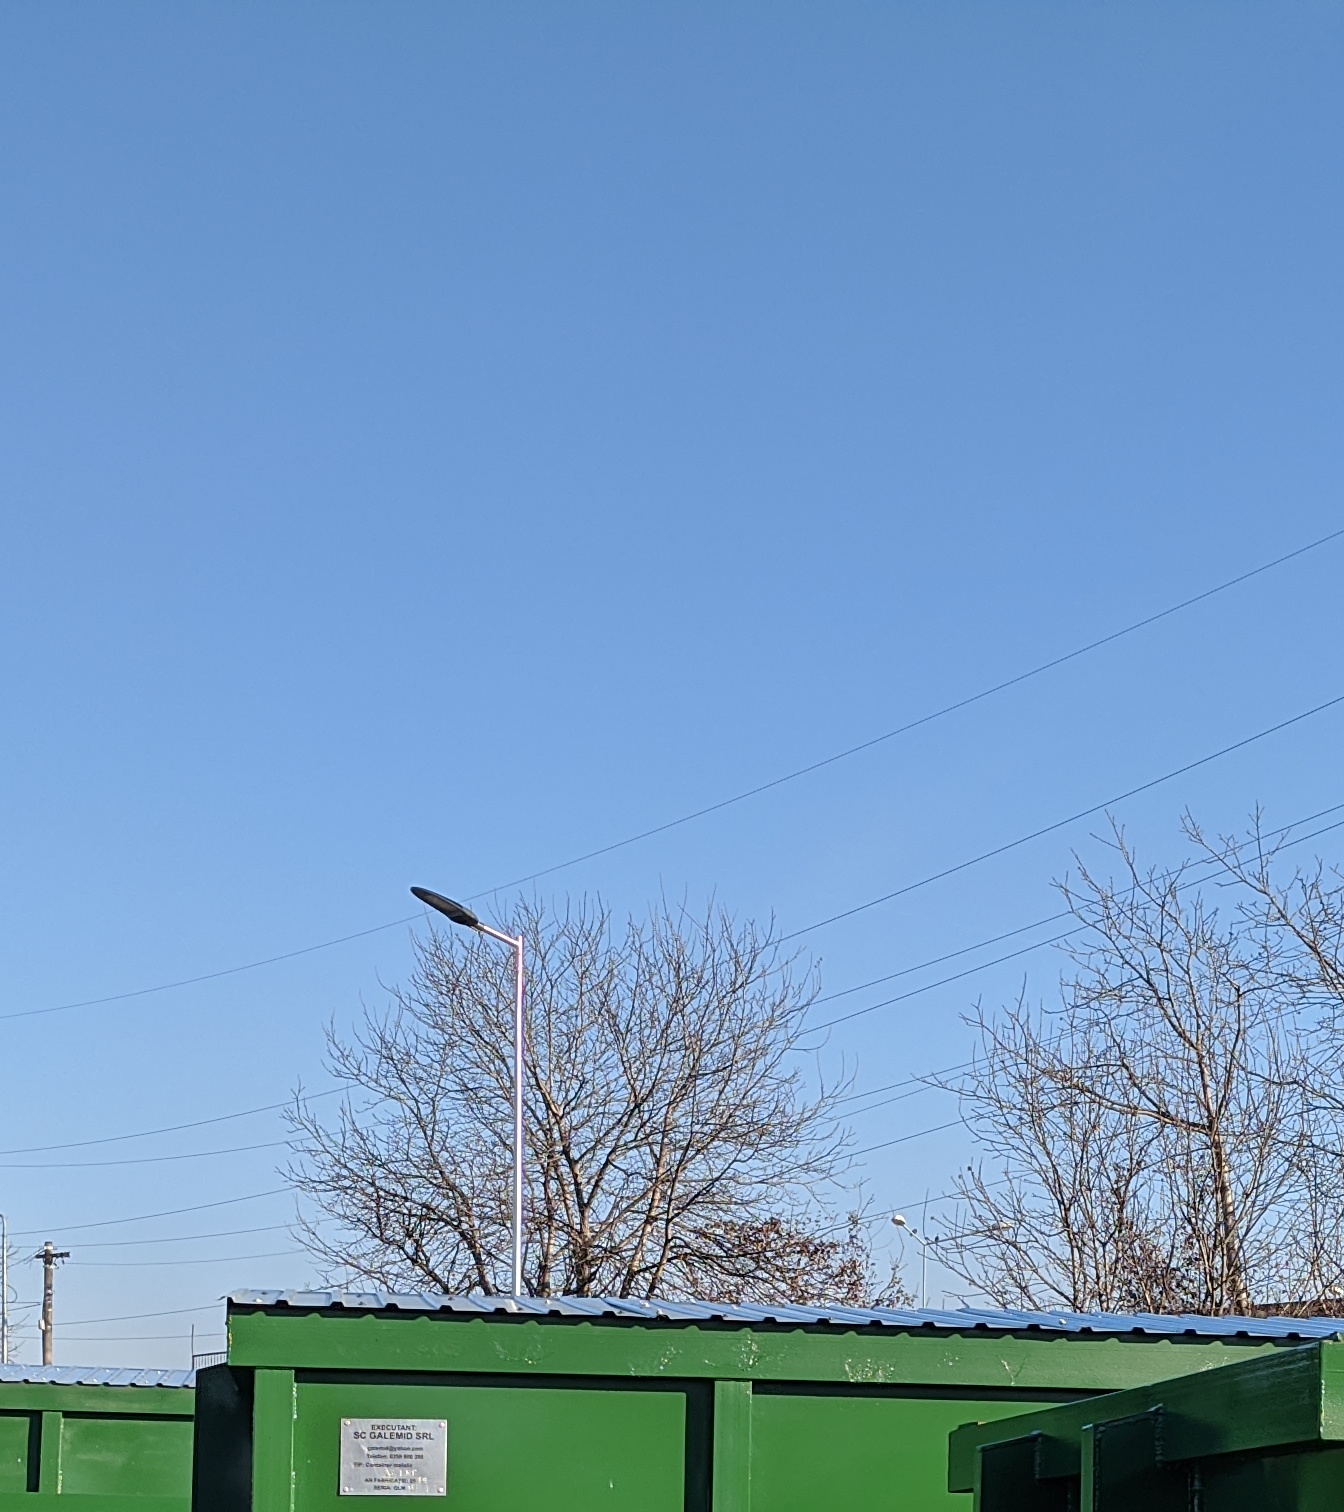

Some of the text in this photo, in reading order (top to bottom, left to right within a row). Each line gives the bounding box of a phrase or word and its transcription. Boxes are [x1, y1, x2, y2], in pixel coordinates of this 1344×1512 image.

[353, 1431, 435, 1441] SC GALEMID SRL
